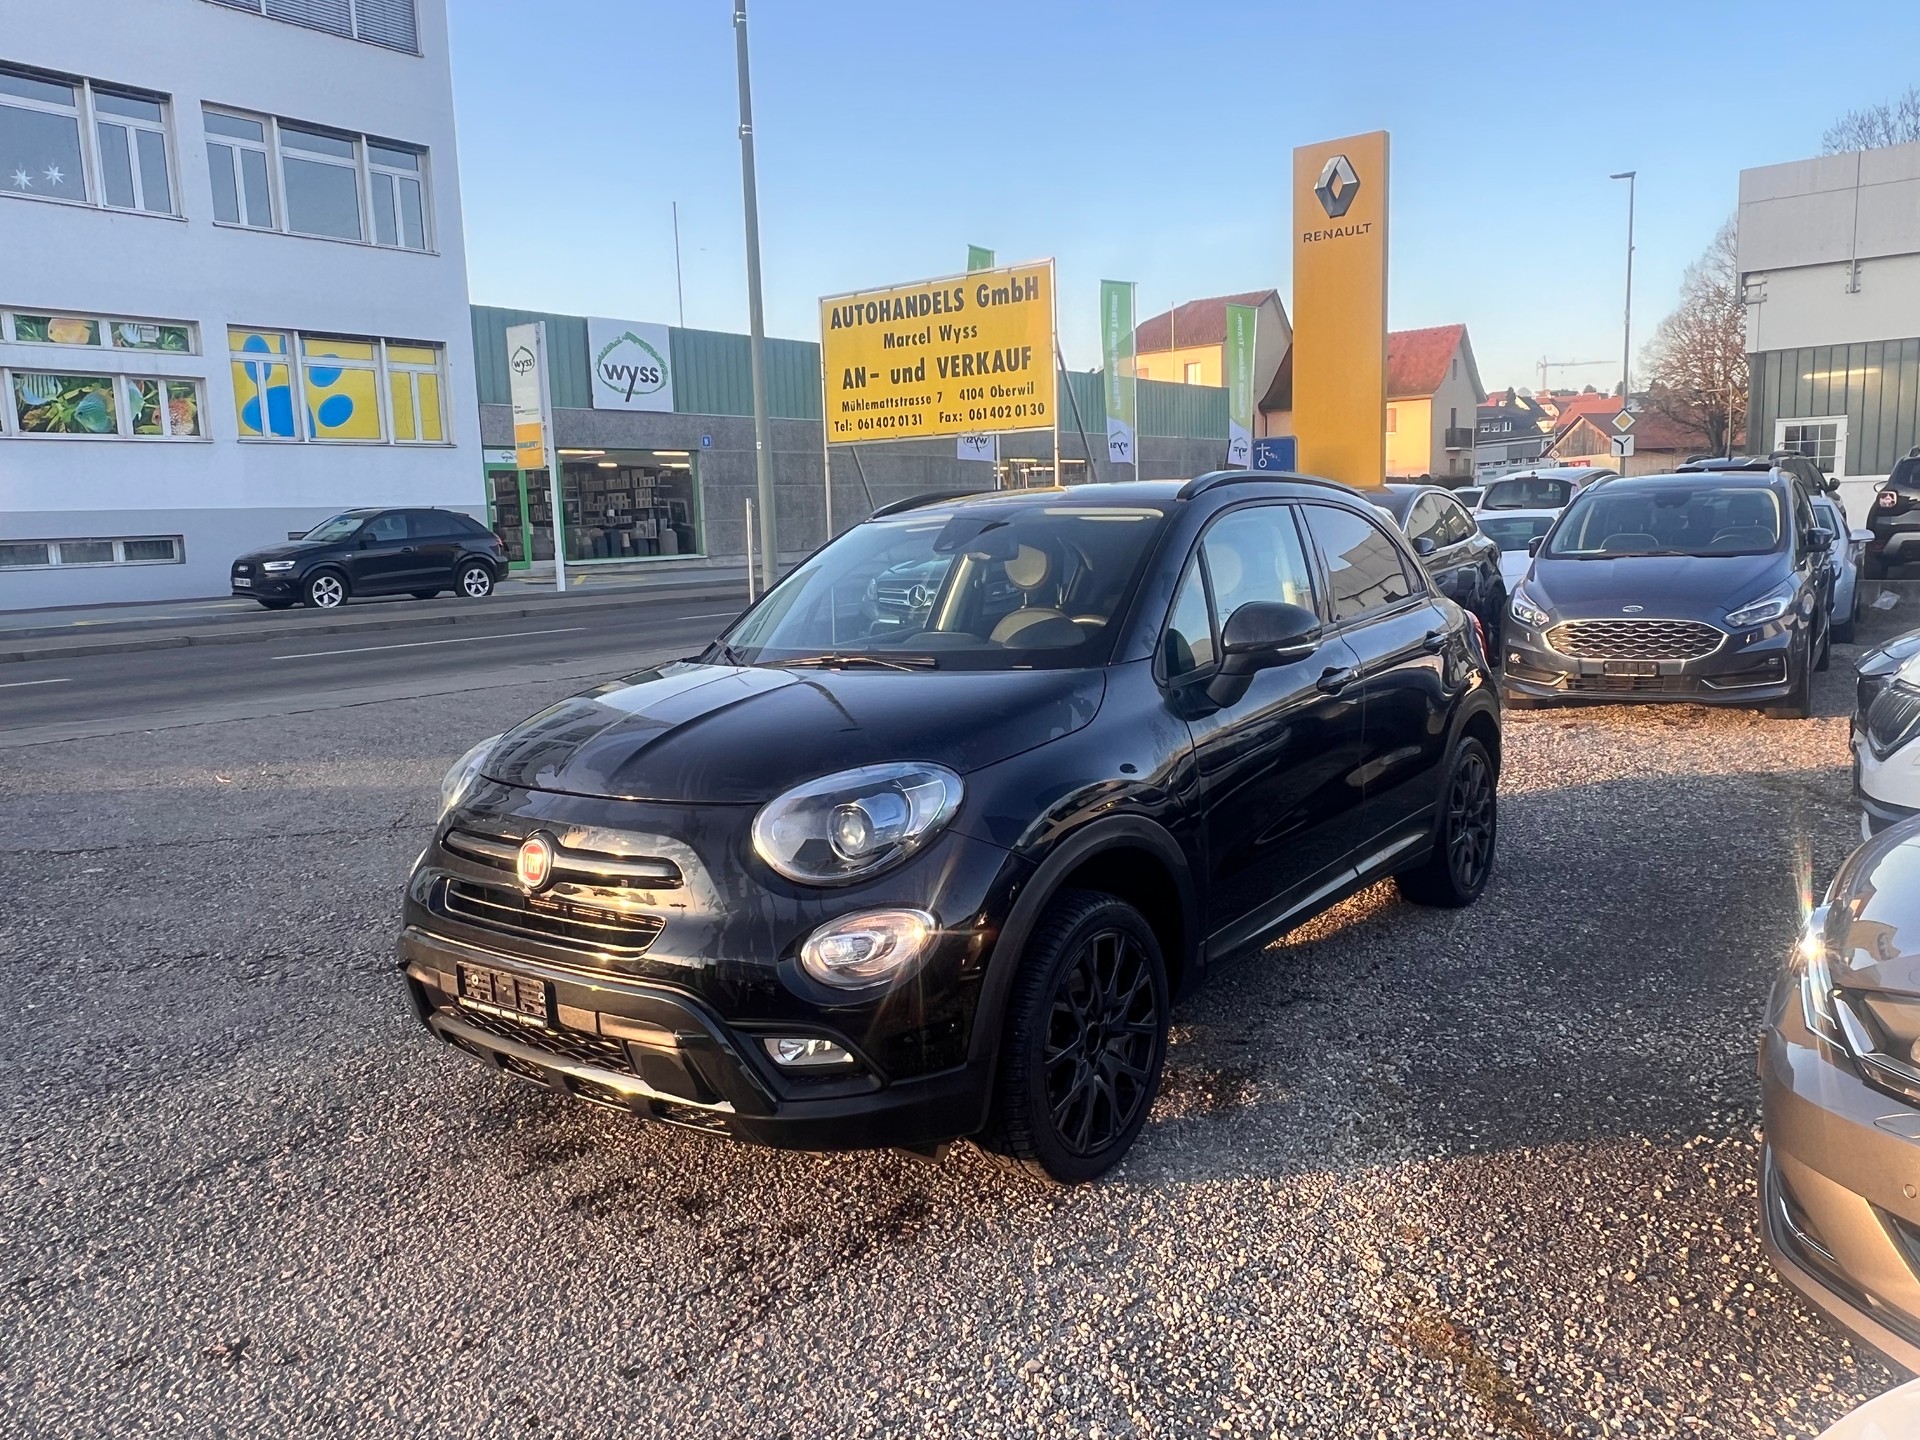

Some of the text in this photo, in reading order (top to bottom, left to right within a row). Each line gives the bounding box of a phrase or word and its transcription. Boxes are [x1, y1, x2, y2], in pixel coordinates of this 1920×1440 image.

[1303, 223, 1372, 242] RENAULT
[831, 276, 1038, 330] AUTOHANDELS GmbH
[884, 324, 977, 349] Marcel Wyss
[514, 359, 532, 376] wyss
[890, 357, 925, 384] und
[937, 346, 1031, 378] VERKAUF
[603, 363, 659, 402] wyss
[842, 381, 1034, 412] Mühlemattstrasse 7 4104 Oberwil
[835, 419, 852, 432] Tel:
[940, 412, 962, 424] Fax:
